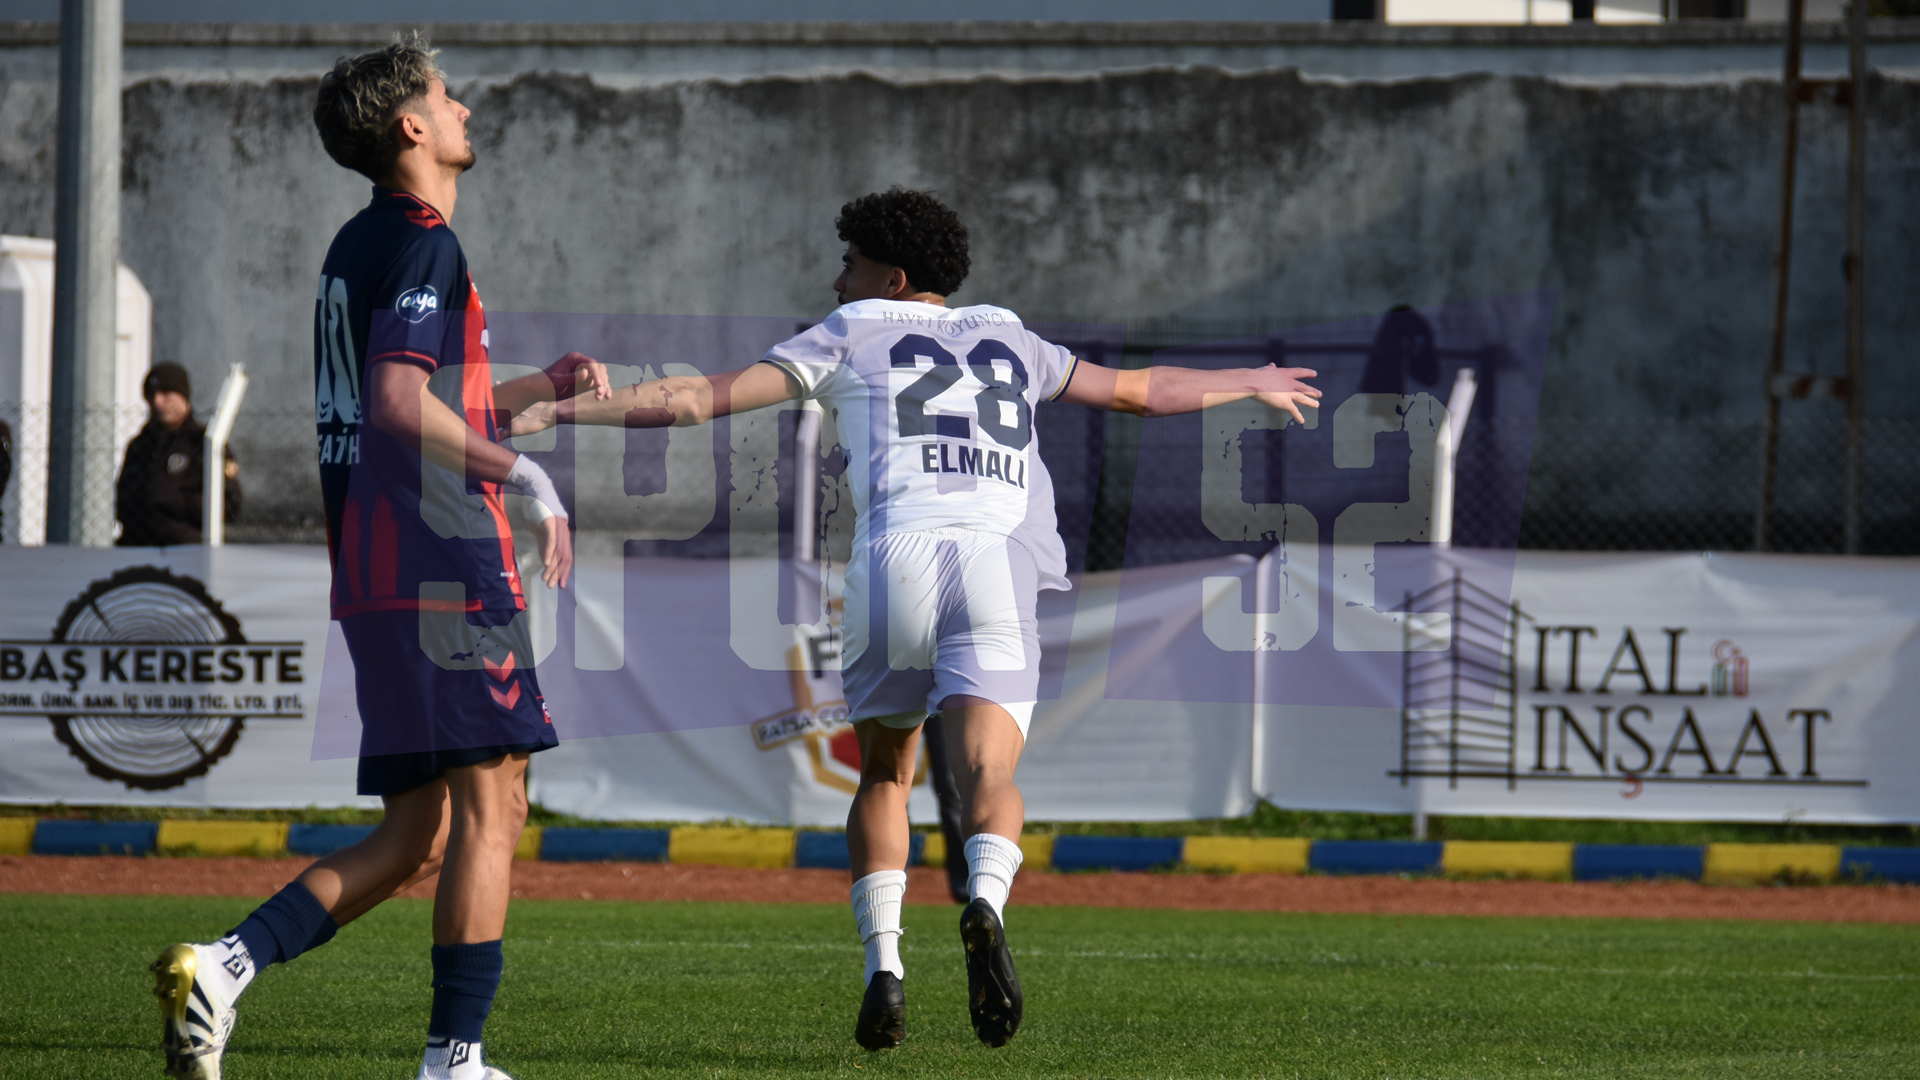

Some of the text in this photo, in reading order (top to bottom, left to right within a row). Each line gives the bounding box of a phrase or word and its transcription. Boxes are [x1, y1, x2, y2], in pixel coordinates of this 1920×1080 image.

[889, 333, 1032, 451] 28
[921, 443, 1026, 490] ELMALI
[0, 648, 304, 692] BAŞ KERESTE
[143, 694, 163, 708] VE
